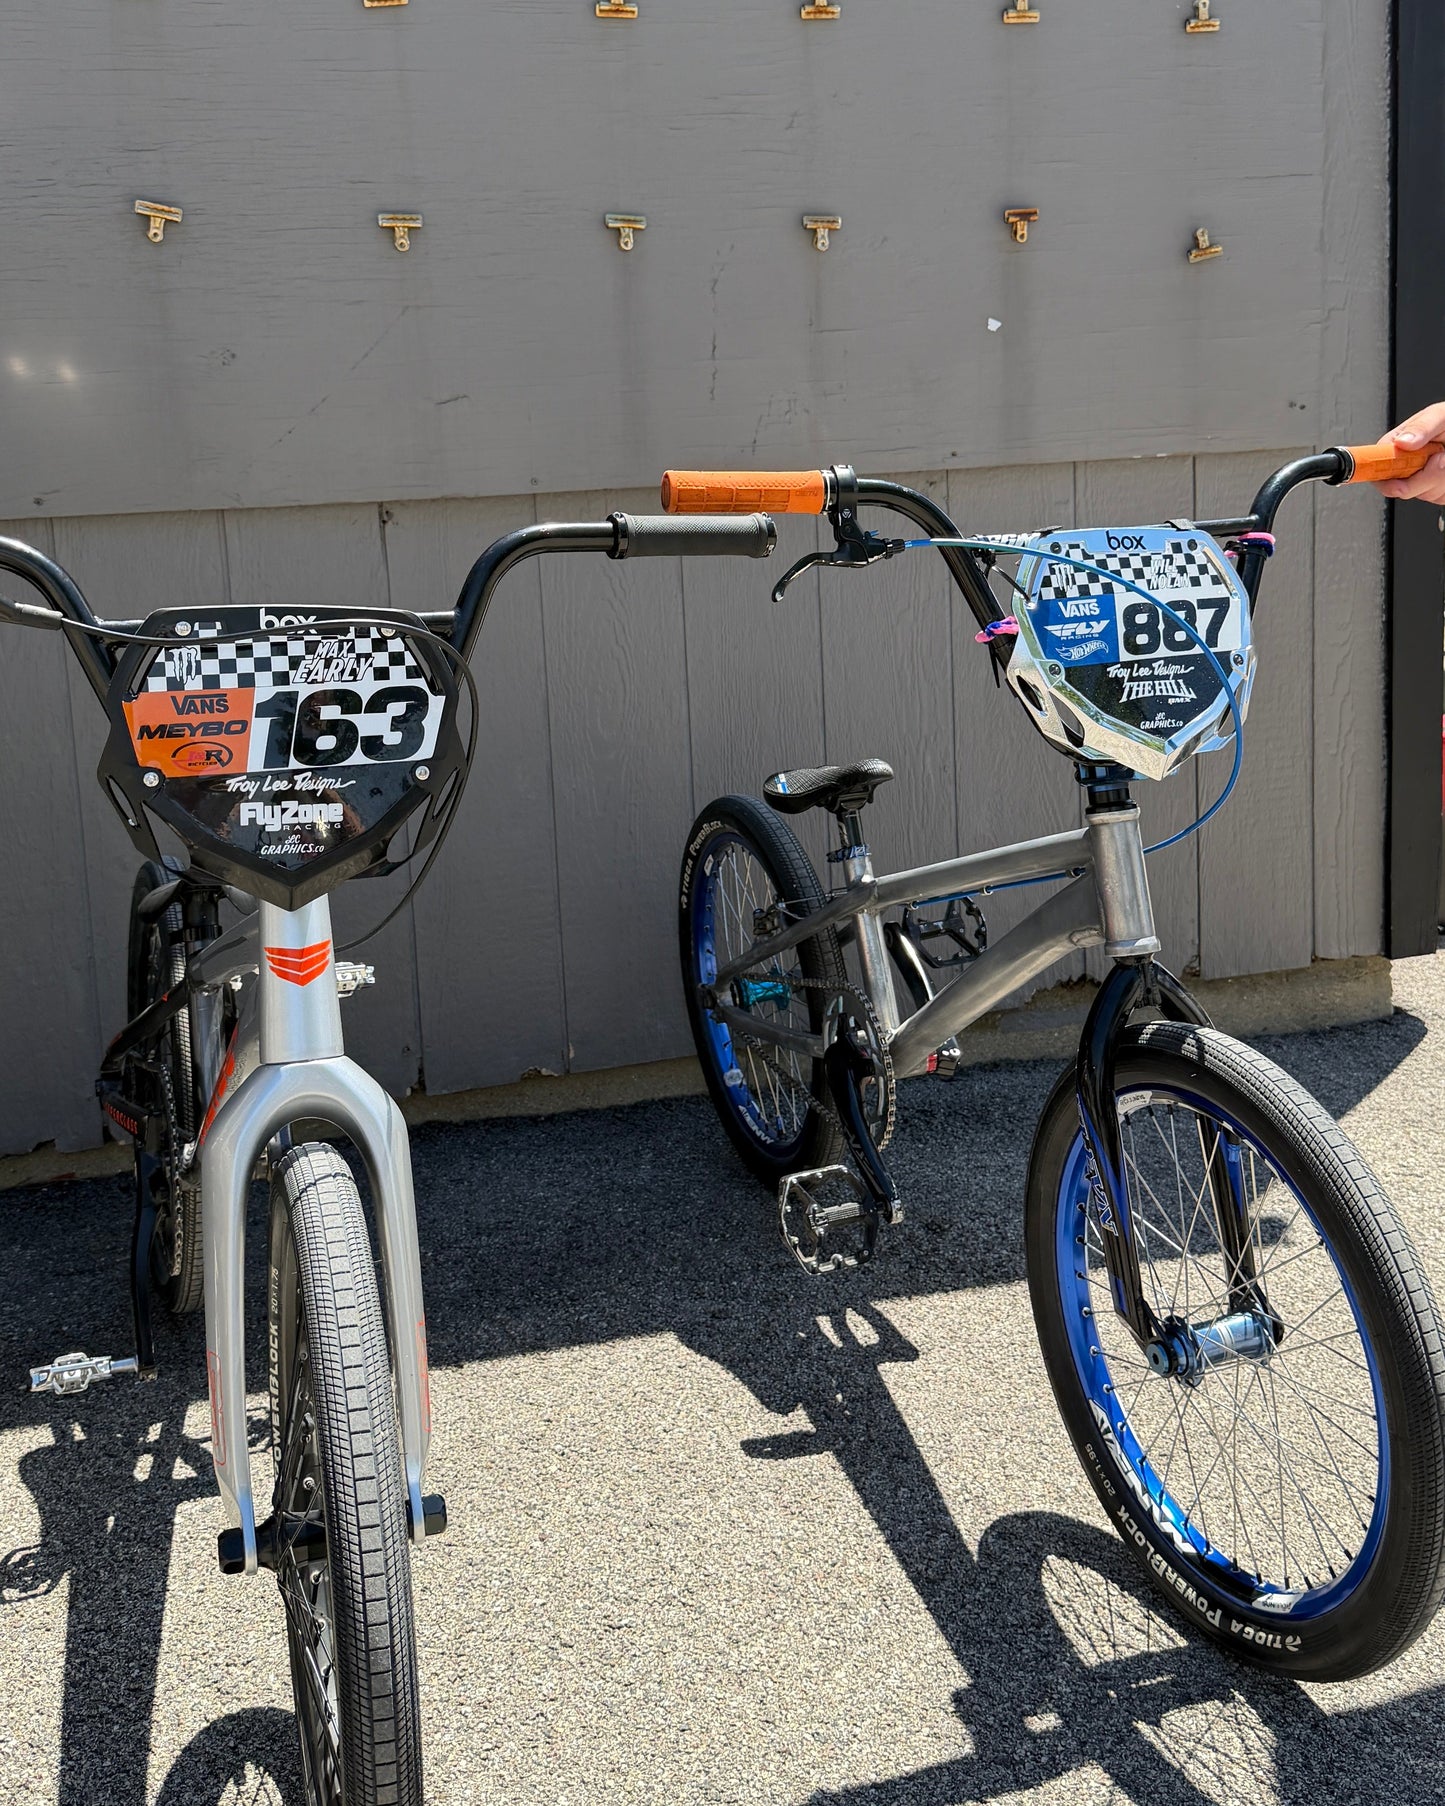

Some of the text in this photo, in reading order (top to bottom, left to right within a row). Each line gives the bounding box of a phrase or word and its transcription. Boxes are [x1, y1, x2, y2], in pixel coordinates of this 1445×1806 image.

[1106, 530, 1146, 550] box
[1150, 558, 1178, 574] WILL
[1149, 573, 1190, 590] NOLAN
[259, 607, 317, 634] box
[1058, 599, 1100, 618] VANS
[1043, 620, 1110, 637] FLY
[1122, 597, 1230, 656] 887
[313, 641, 352, 659] MAX
[291, 656, 374, 684] EARLY
[1107, 660, 1195, 684] Troy Lee Designs
[1119, 679, 1197, 703] THE HILL
[170, 693, 230, 716] VANS
[136, 719, 249, 741] MEYBO
[254, 685, 429, 767] 163
[225, 771, 356, 799] Troy Lee Designs
[1116, 1504, 1223, 1629] POWERBLOCK
[1230, 1620, 1283, 1649] TIOGA
